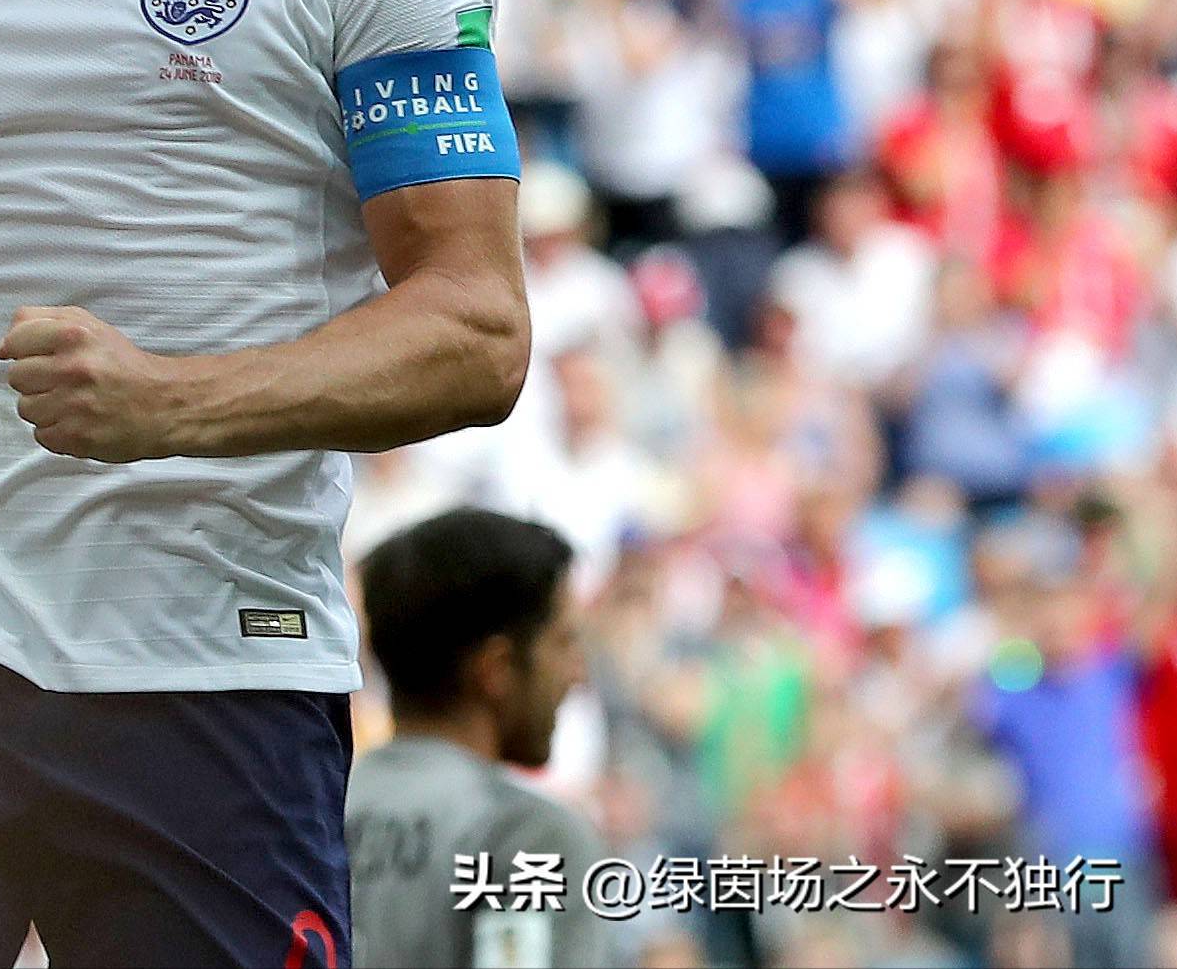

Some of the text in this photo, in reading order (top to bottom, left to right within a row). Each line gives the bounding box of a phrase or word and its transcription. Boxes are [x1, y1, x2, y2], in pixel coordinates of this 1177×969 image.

[168, 53, 213, 69] PANAMA
[159, 67, 171, 80] 24
[174, 69, 197, 82] JUNE
[436, 131, 495, 155] FIFA
